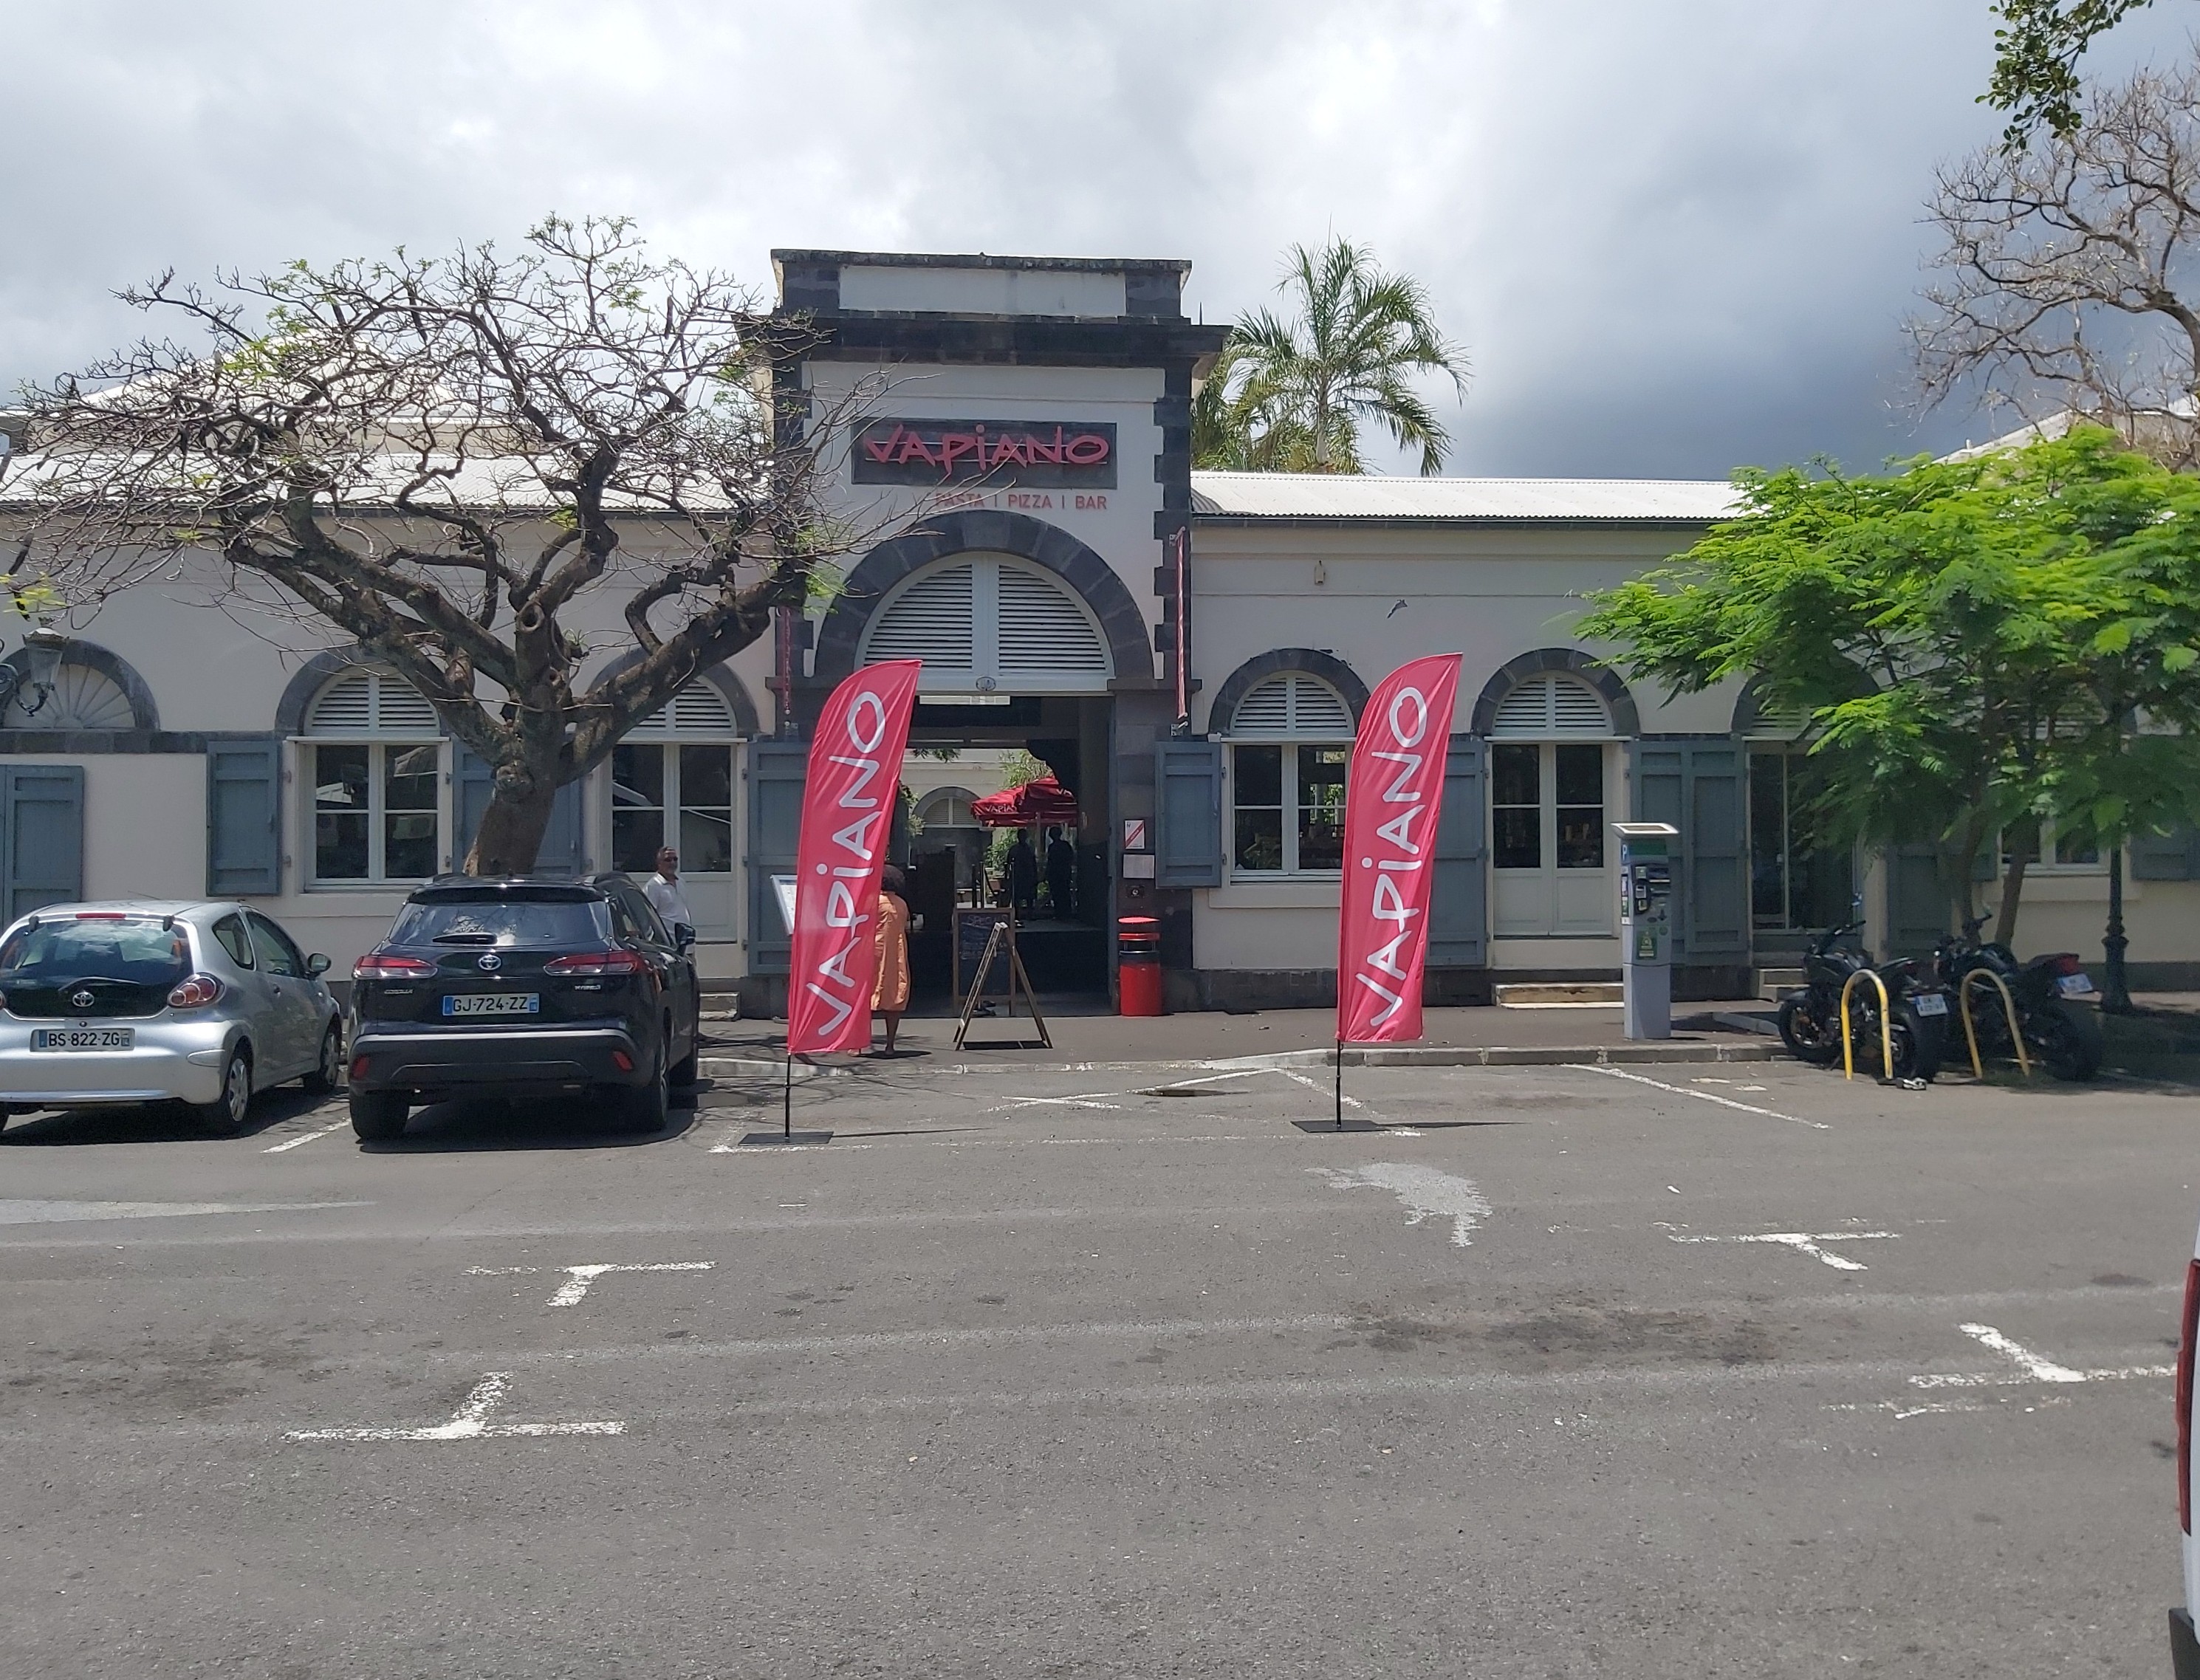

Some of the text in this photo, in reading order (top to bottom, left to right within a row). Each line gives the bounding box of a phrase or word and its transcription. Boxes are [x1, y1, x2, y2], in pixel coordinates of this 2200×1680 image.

[1008, 494, 1052, 508] PIZZA
[1075, 495, 1107, 510] BAR
[453, 996, 528, 1012] GJ-724-ZZ
[48, 1032, 120, 1046] BS-822-ZG
